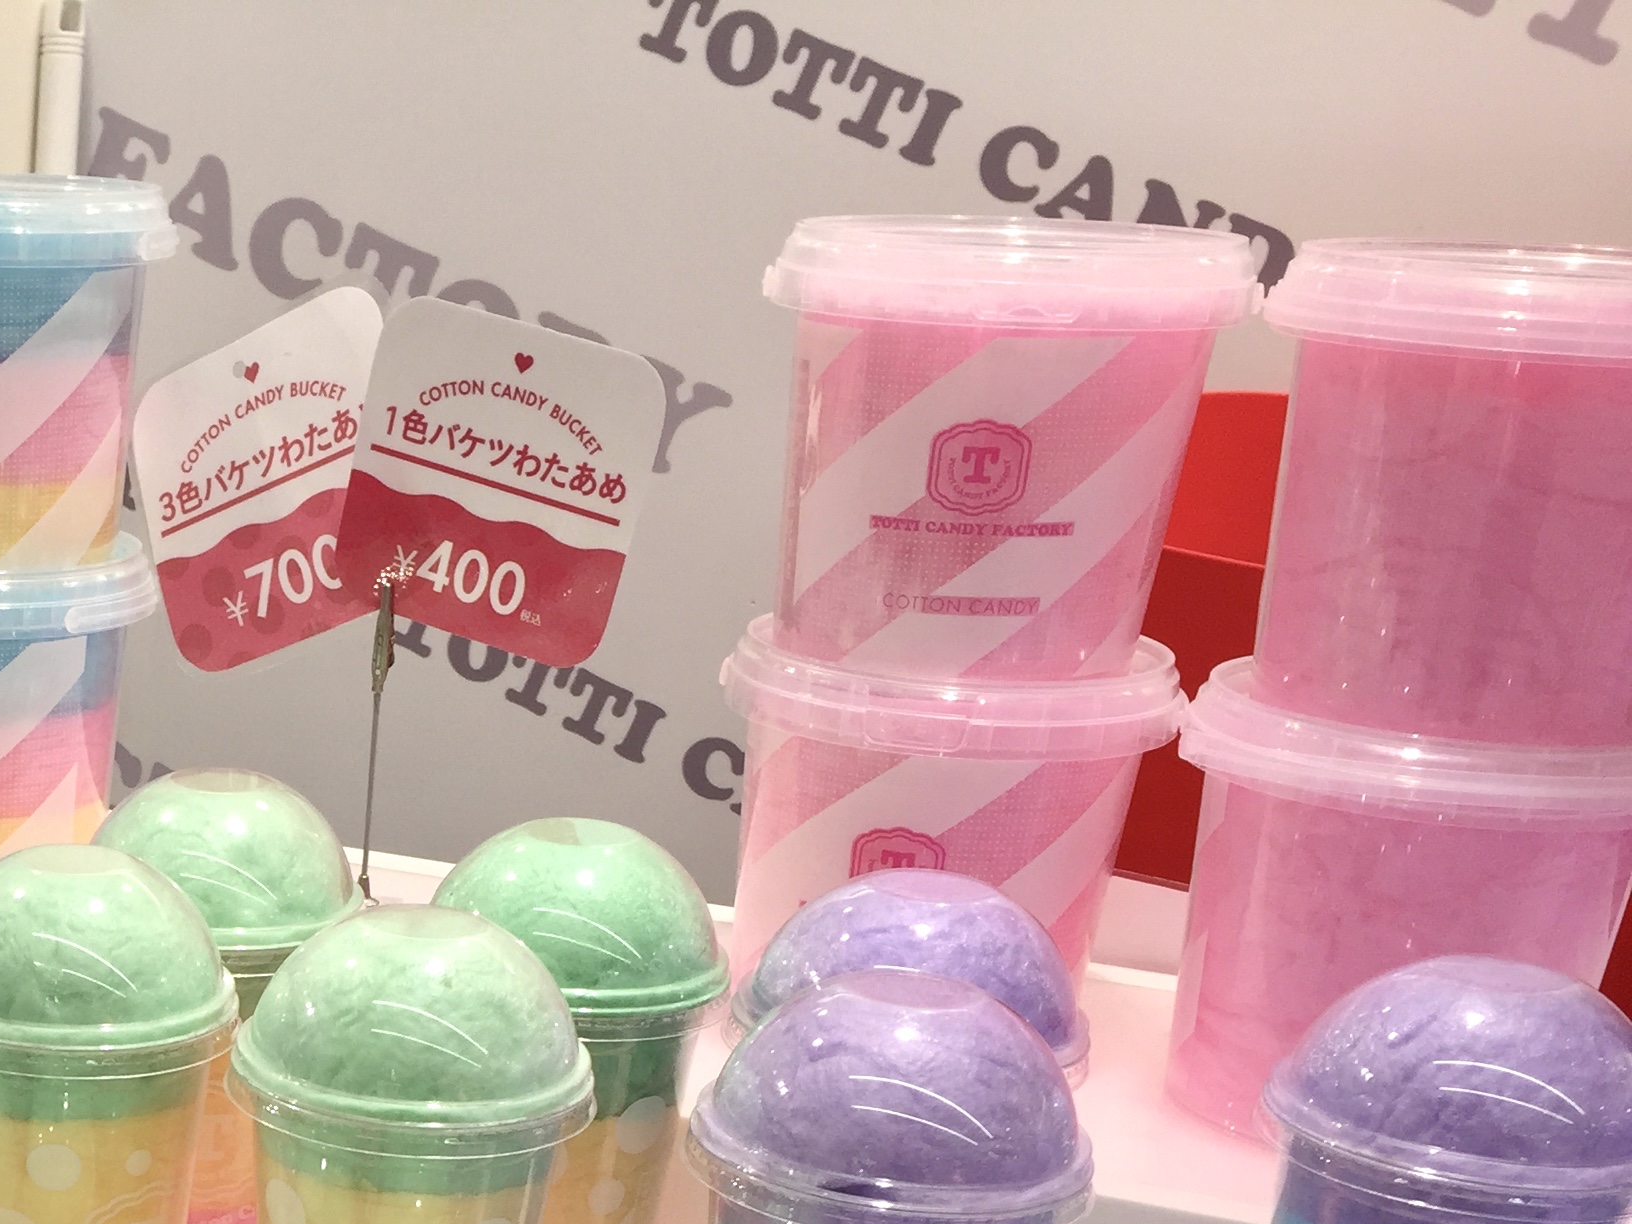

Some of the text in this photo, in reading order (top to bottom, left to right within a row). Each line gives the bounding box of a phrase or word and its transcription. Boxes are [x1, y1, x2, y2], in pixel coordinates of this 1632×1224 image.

[639, 0, 963, 166] TOTTI
[180, 380, 347, 474] COTTON CANDY BUCKET
[385, 405, 627, 505] 1色バケツわたあめ
[419, 379, 603, 456] COTTON CANDY BUCKET
[158, 403, 364, 523] 3色バケツわたあ
[961, 446, 1001, 484] T
[871, 515, 1073, 536] TOTTI CANDY FACTORY
[882, 592, 1038, 615] COTTON CANDY
